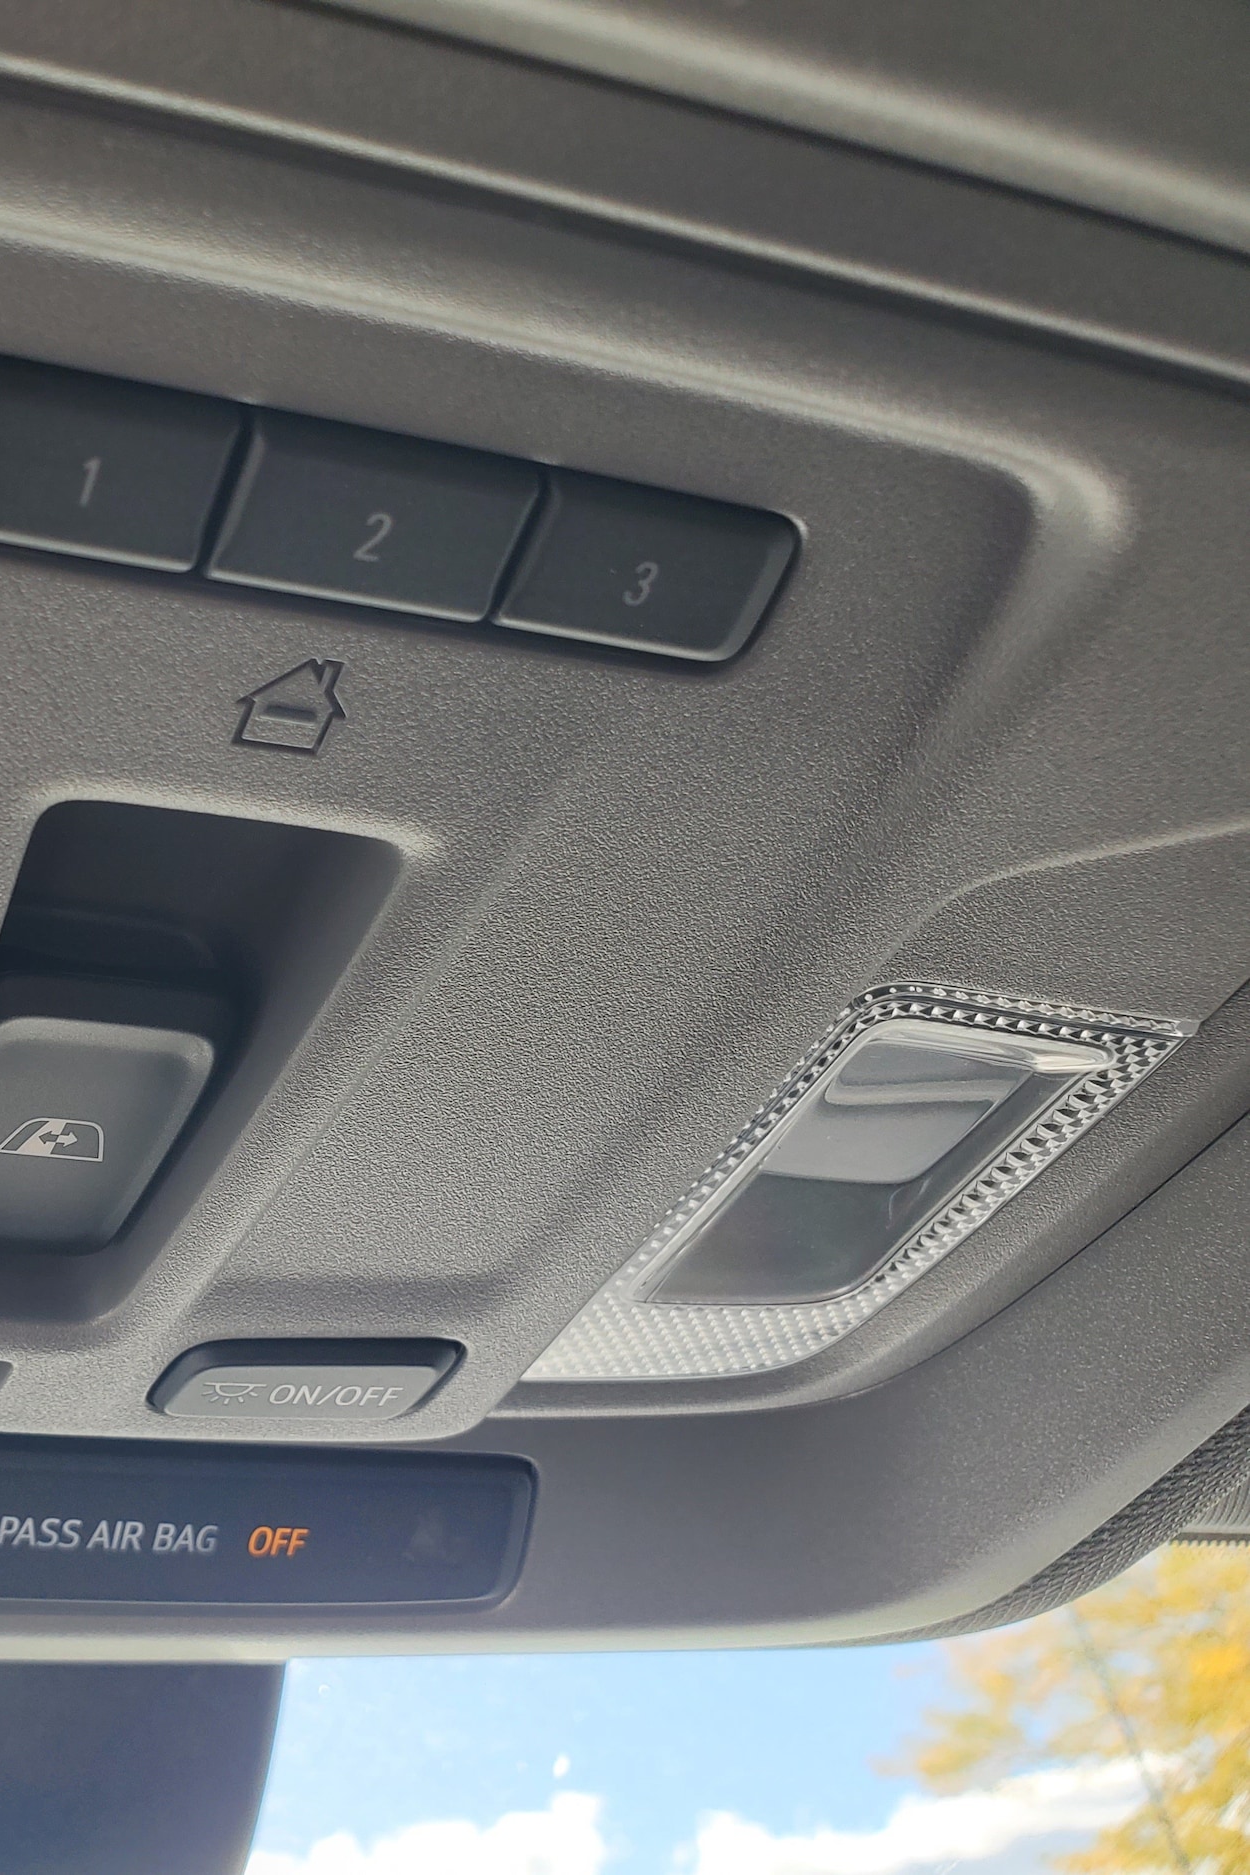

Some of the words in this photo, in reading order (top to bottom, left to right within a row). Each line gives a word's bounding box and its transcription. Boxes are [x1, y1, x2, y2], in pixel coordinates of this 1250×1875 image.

[78, 457, 101, 507] 1
[353, 513, 391, 562] 2
[622, 562, 658, 605] 3
[268, 1383, 403, 1408] ON/OFF
[86, 1520, 143, 1551] AIR
[152, 1523, 219, 1554] BAG
[248, 1526, 309, 1557] OFF
